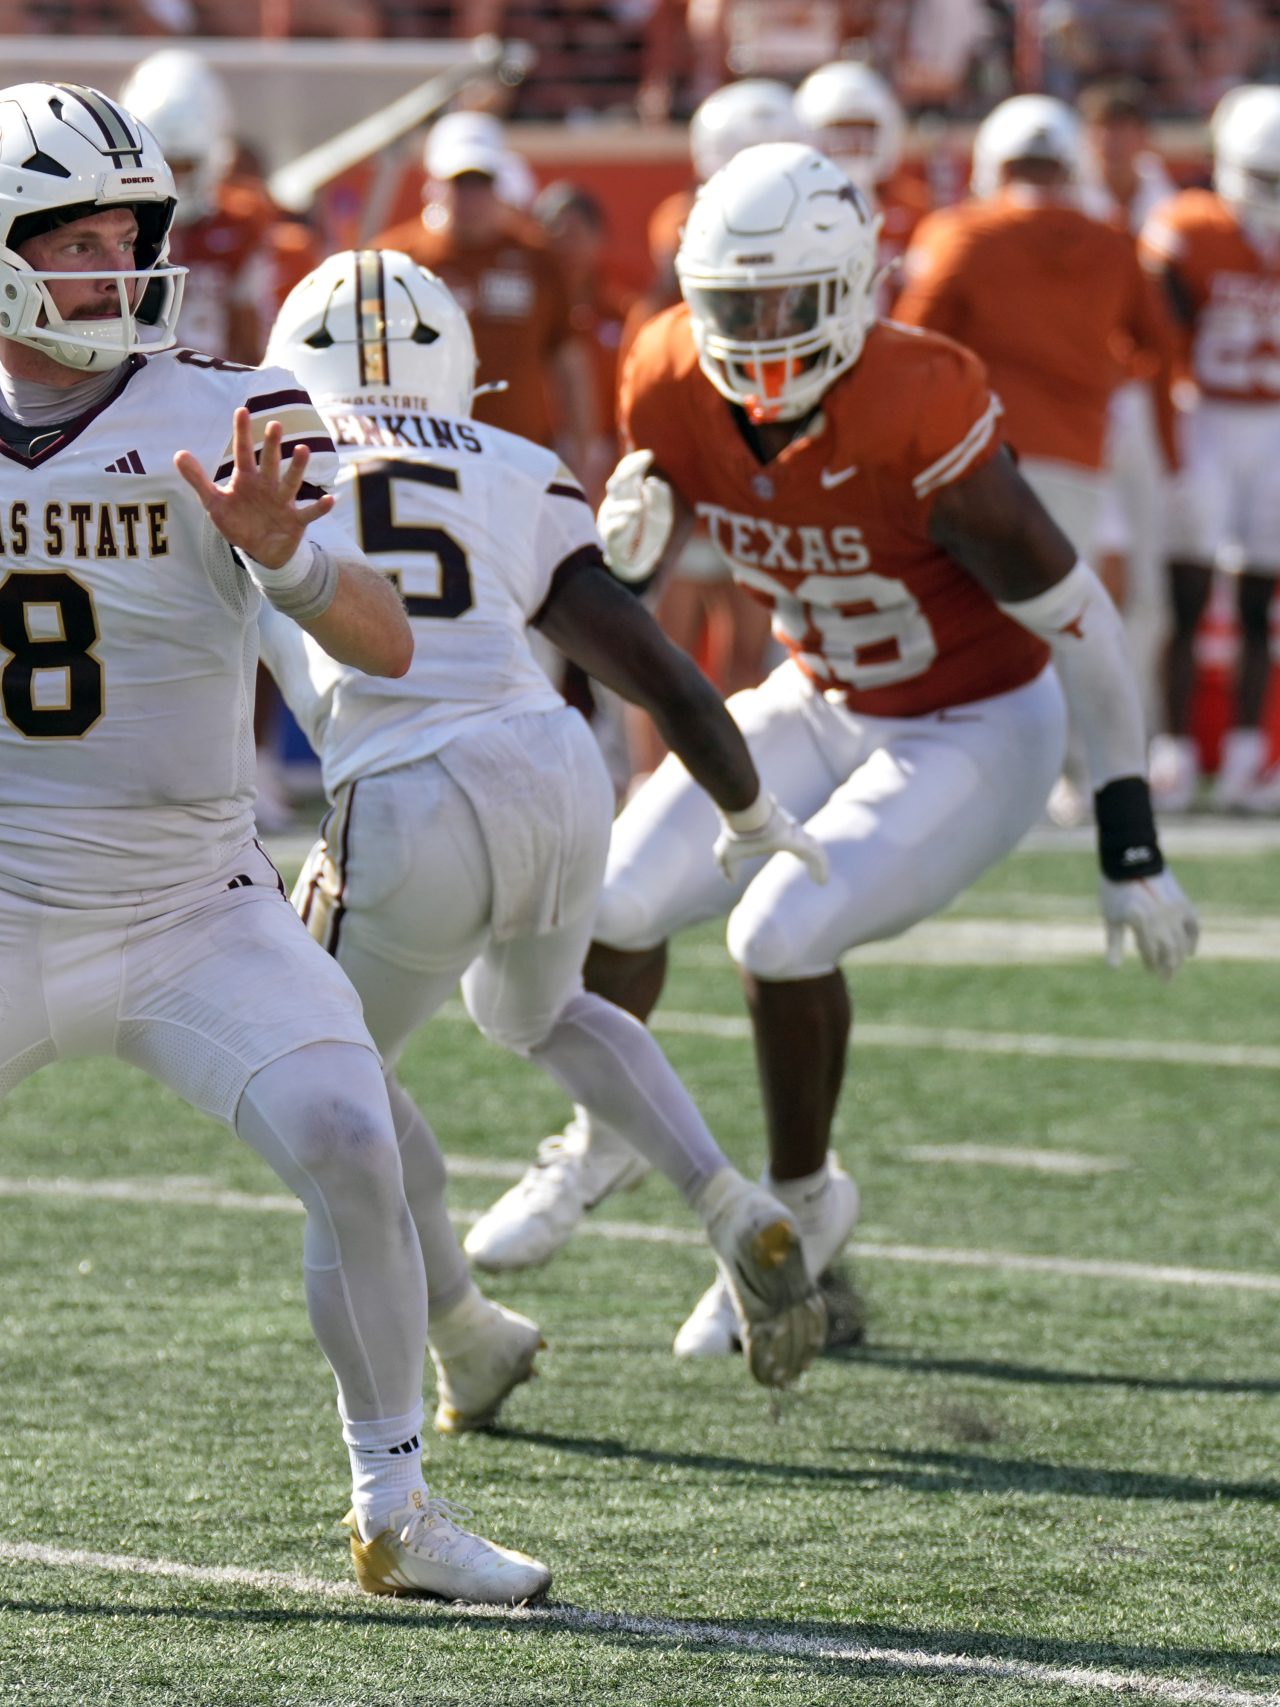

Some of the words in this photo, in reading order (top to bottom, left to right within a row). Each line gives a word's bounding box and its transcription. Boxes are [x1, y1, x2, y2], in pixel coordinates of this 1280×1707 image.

[329, 414, 482, 453] ENKINS
[44, 502, 169, 558] STATE
[354, 457, 476, 618] 5
[695, 501, 870, 573] TEXAS
